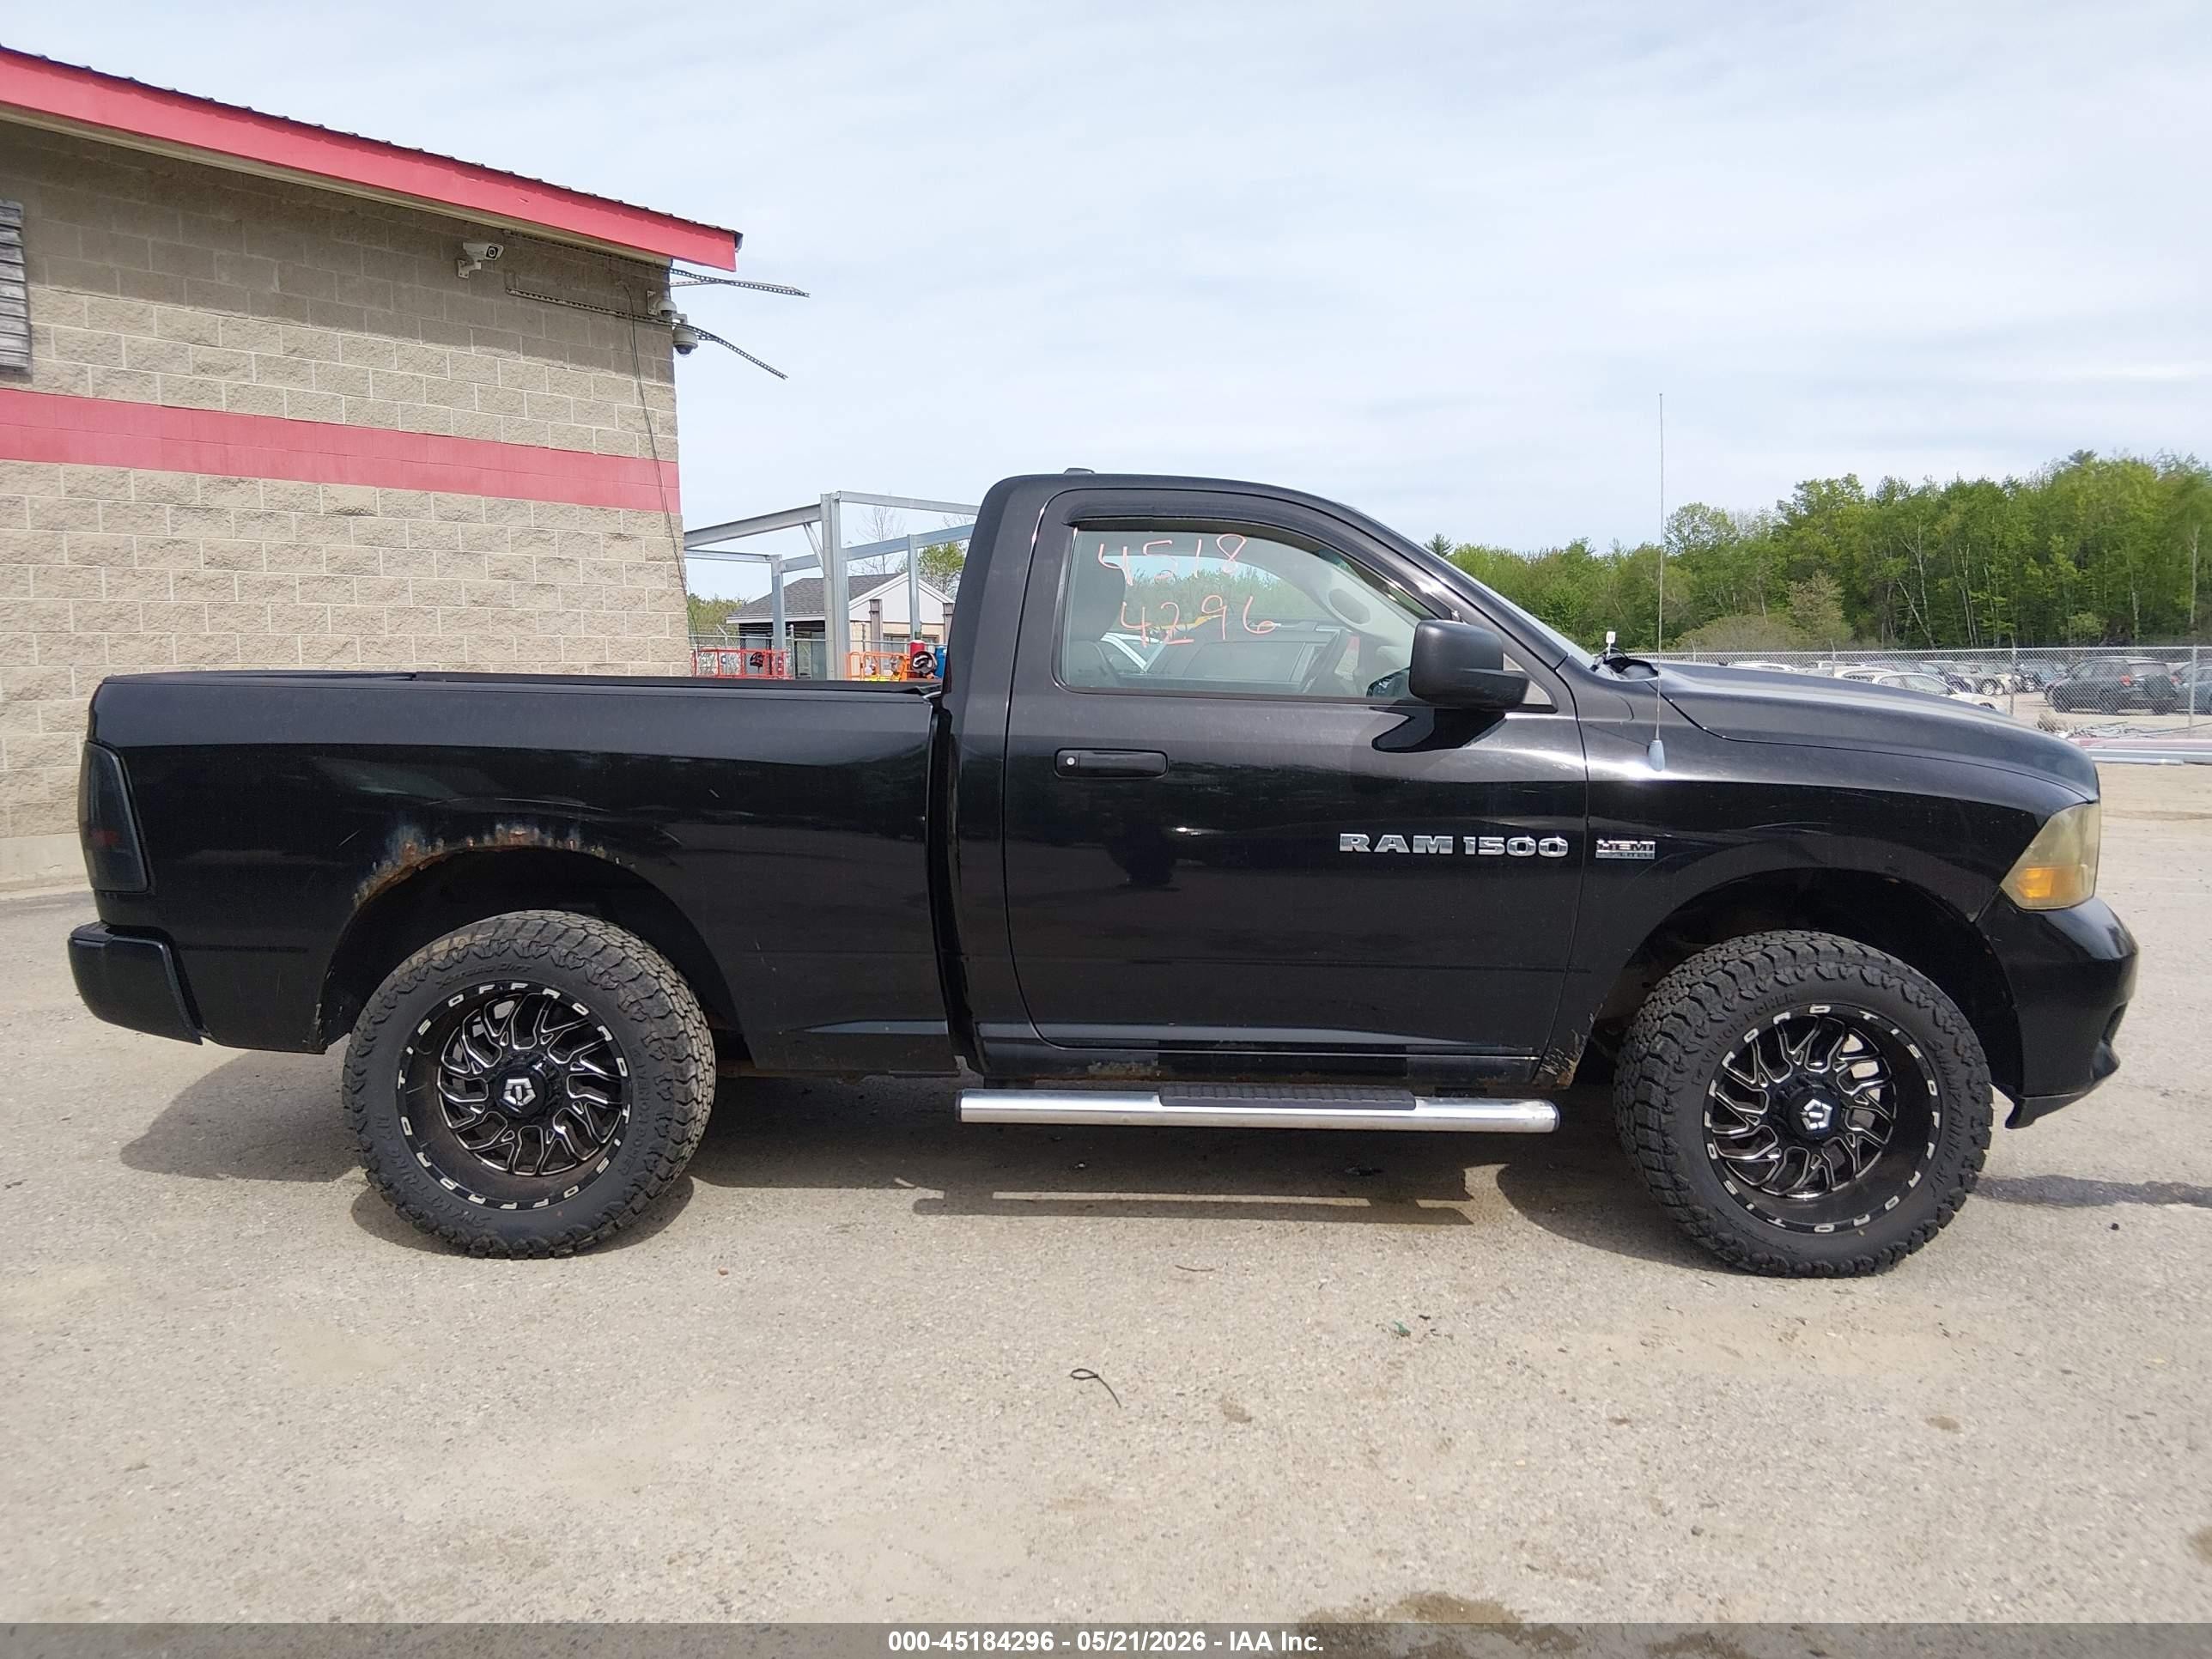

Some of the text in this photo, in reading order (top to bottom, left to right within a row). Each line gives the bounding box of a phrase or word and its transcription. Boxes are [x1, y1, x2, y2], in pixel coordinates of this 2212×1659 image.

[1097, 533, 1248, 586] 4518
[1120, 594, 1276, 647] 4296
[1339, 833, 1569, 857] RAM 1500
[1595, 839, 1656, 853] HEMI
